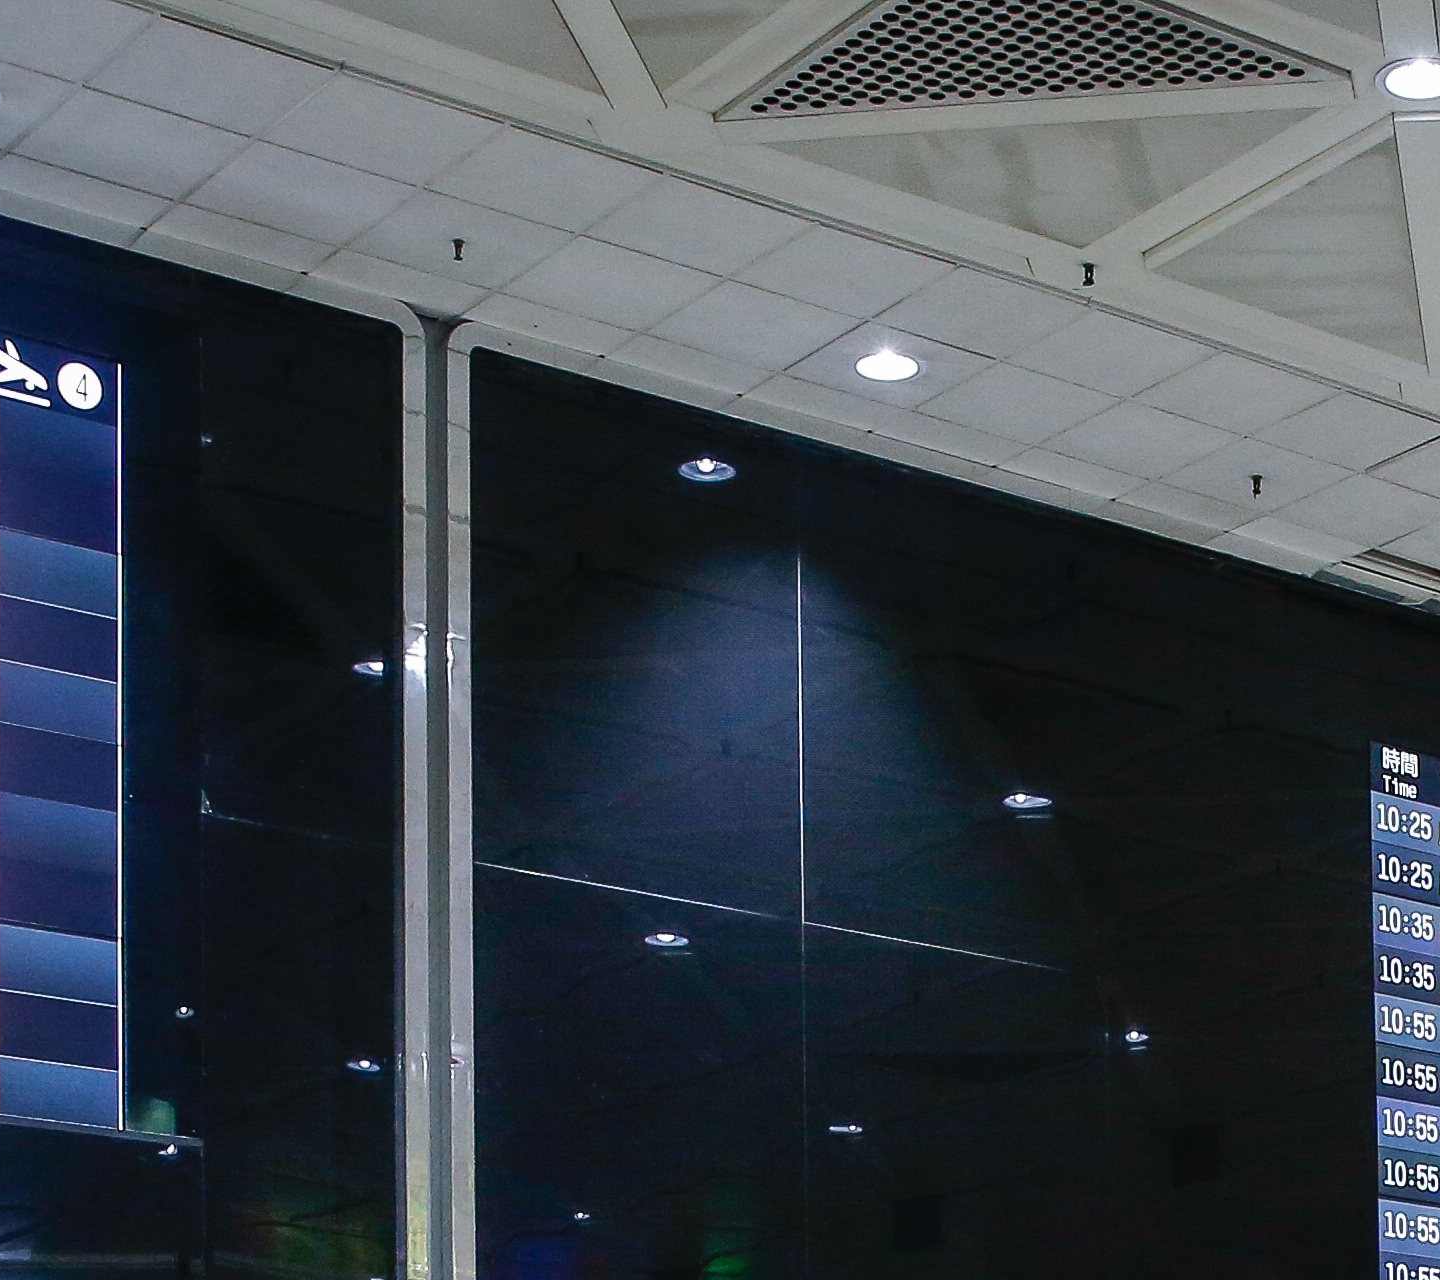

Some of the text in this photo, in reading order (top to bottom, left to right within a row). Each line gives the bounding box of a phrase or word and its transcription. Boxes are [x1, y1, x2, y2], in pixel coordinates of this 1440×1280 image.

[75, 373, 88, 400] 4
[1378, 804, 1431, 839] 10:25
[1379, 906, 1434, 940] 10:35
[1381, 1007, 1435, 1040] 10:55
[1383, 1109, 1437, 1142] 10:55
